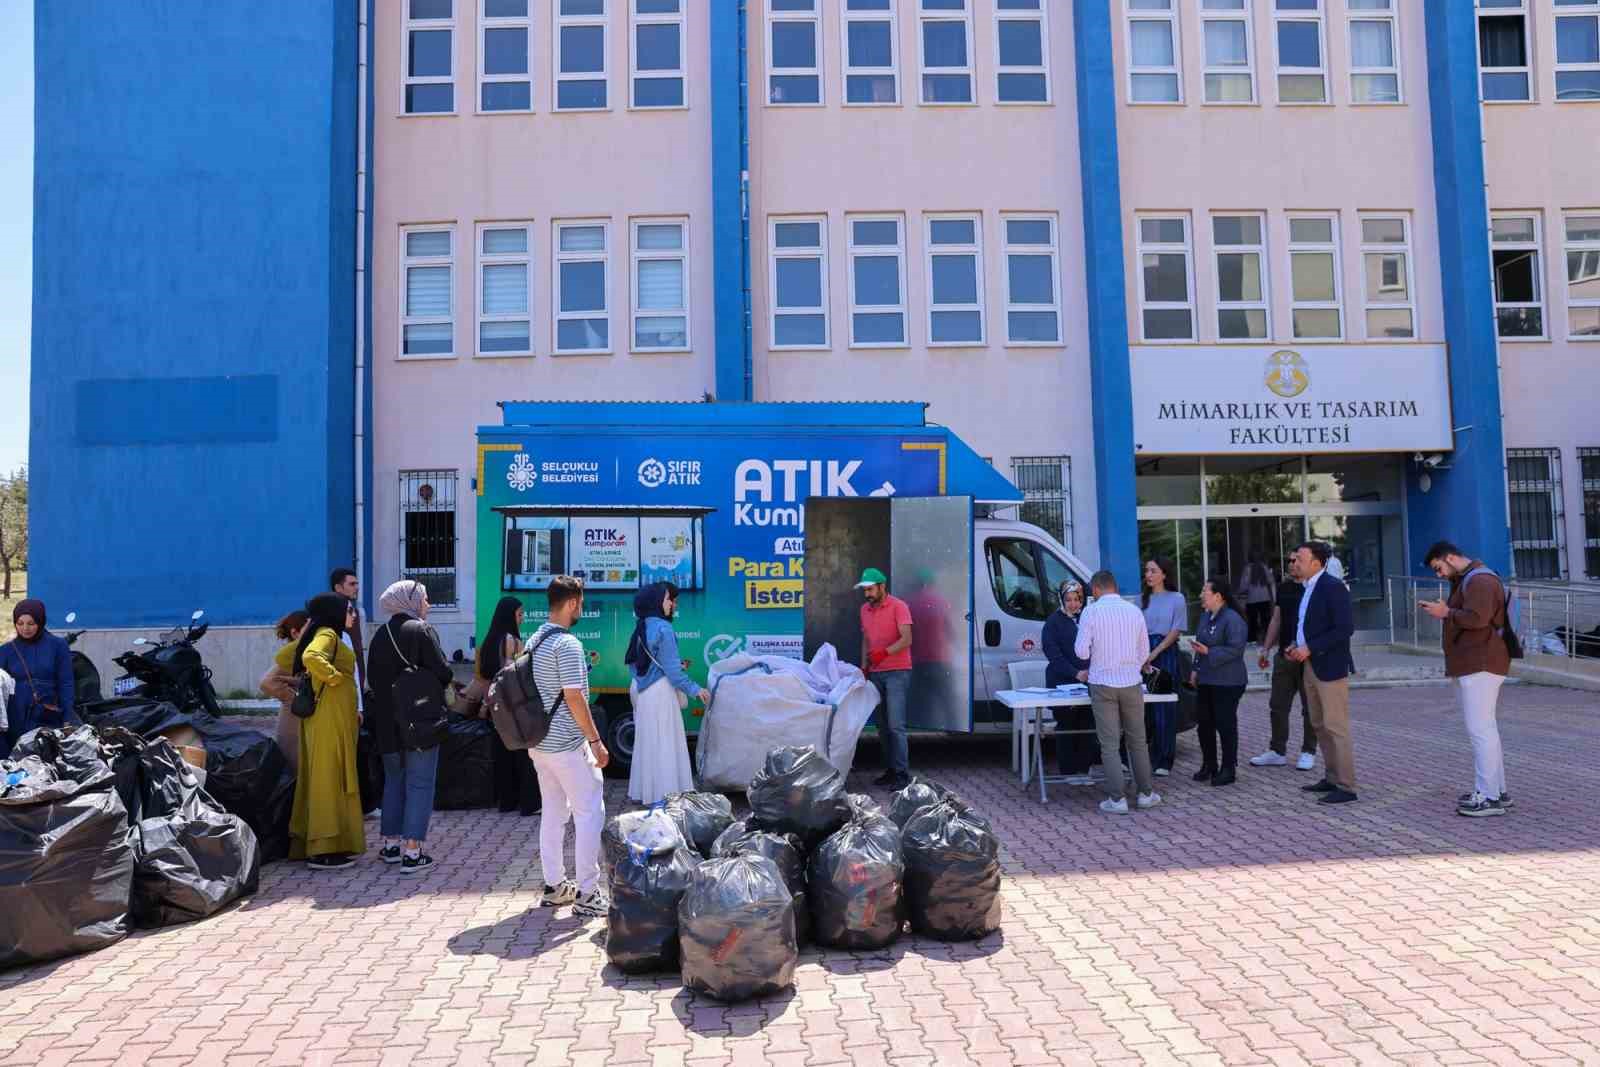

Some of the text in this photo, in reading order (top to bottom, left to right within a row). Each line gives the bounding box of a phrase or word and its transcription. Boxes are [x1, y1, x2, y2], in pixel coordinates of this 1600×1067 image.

[1158, 400, 1419, 421] MİMARLIK VE TASARIM
[1229, 423, 1351, 445] FAKÜLTESİ
[541, 462, 599, 474] SELÇUKLU
[667, 460, 701, 473] SIFIR
[541, 473, 599, 484] BELEDİYESİ
[667, 473, 701, 485] ATIK
[734, 459, 863, 502] ATIK
[734, 503, 805, 534] Kum
[584, 528, 618, 541] ATIK
[728, 557, 785, 577] Para
